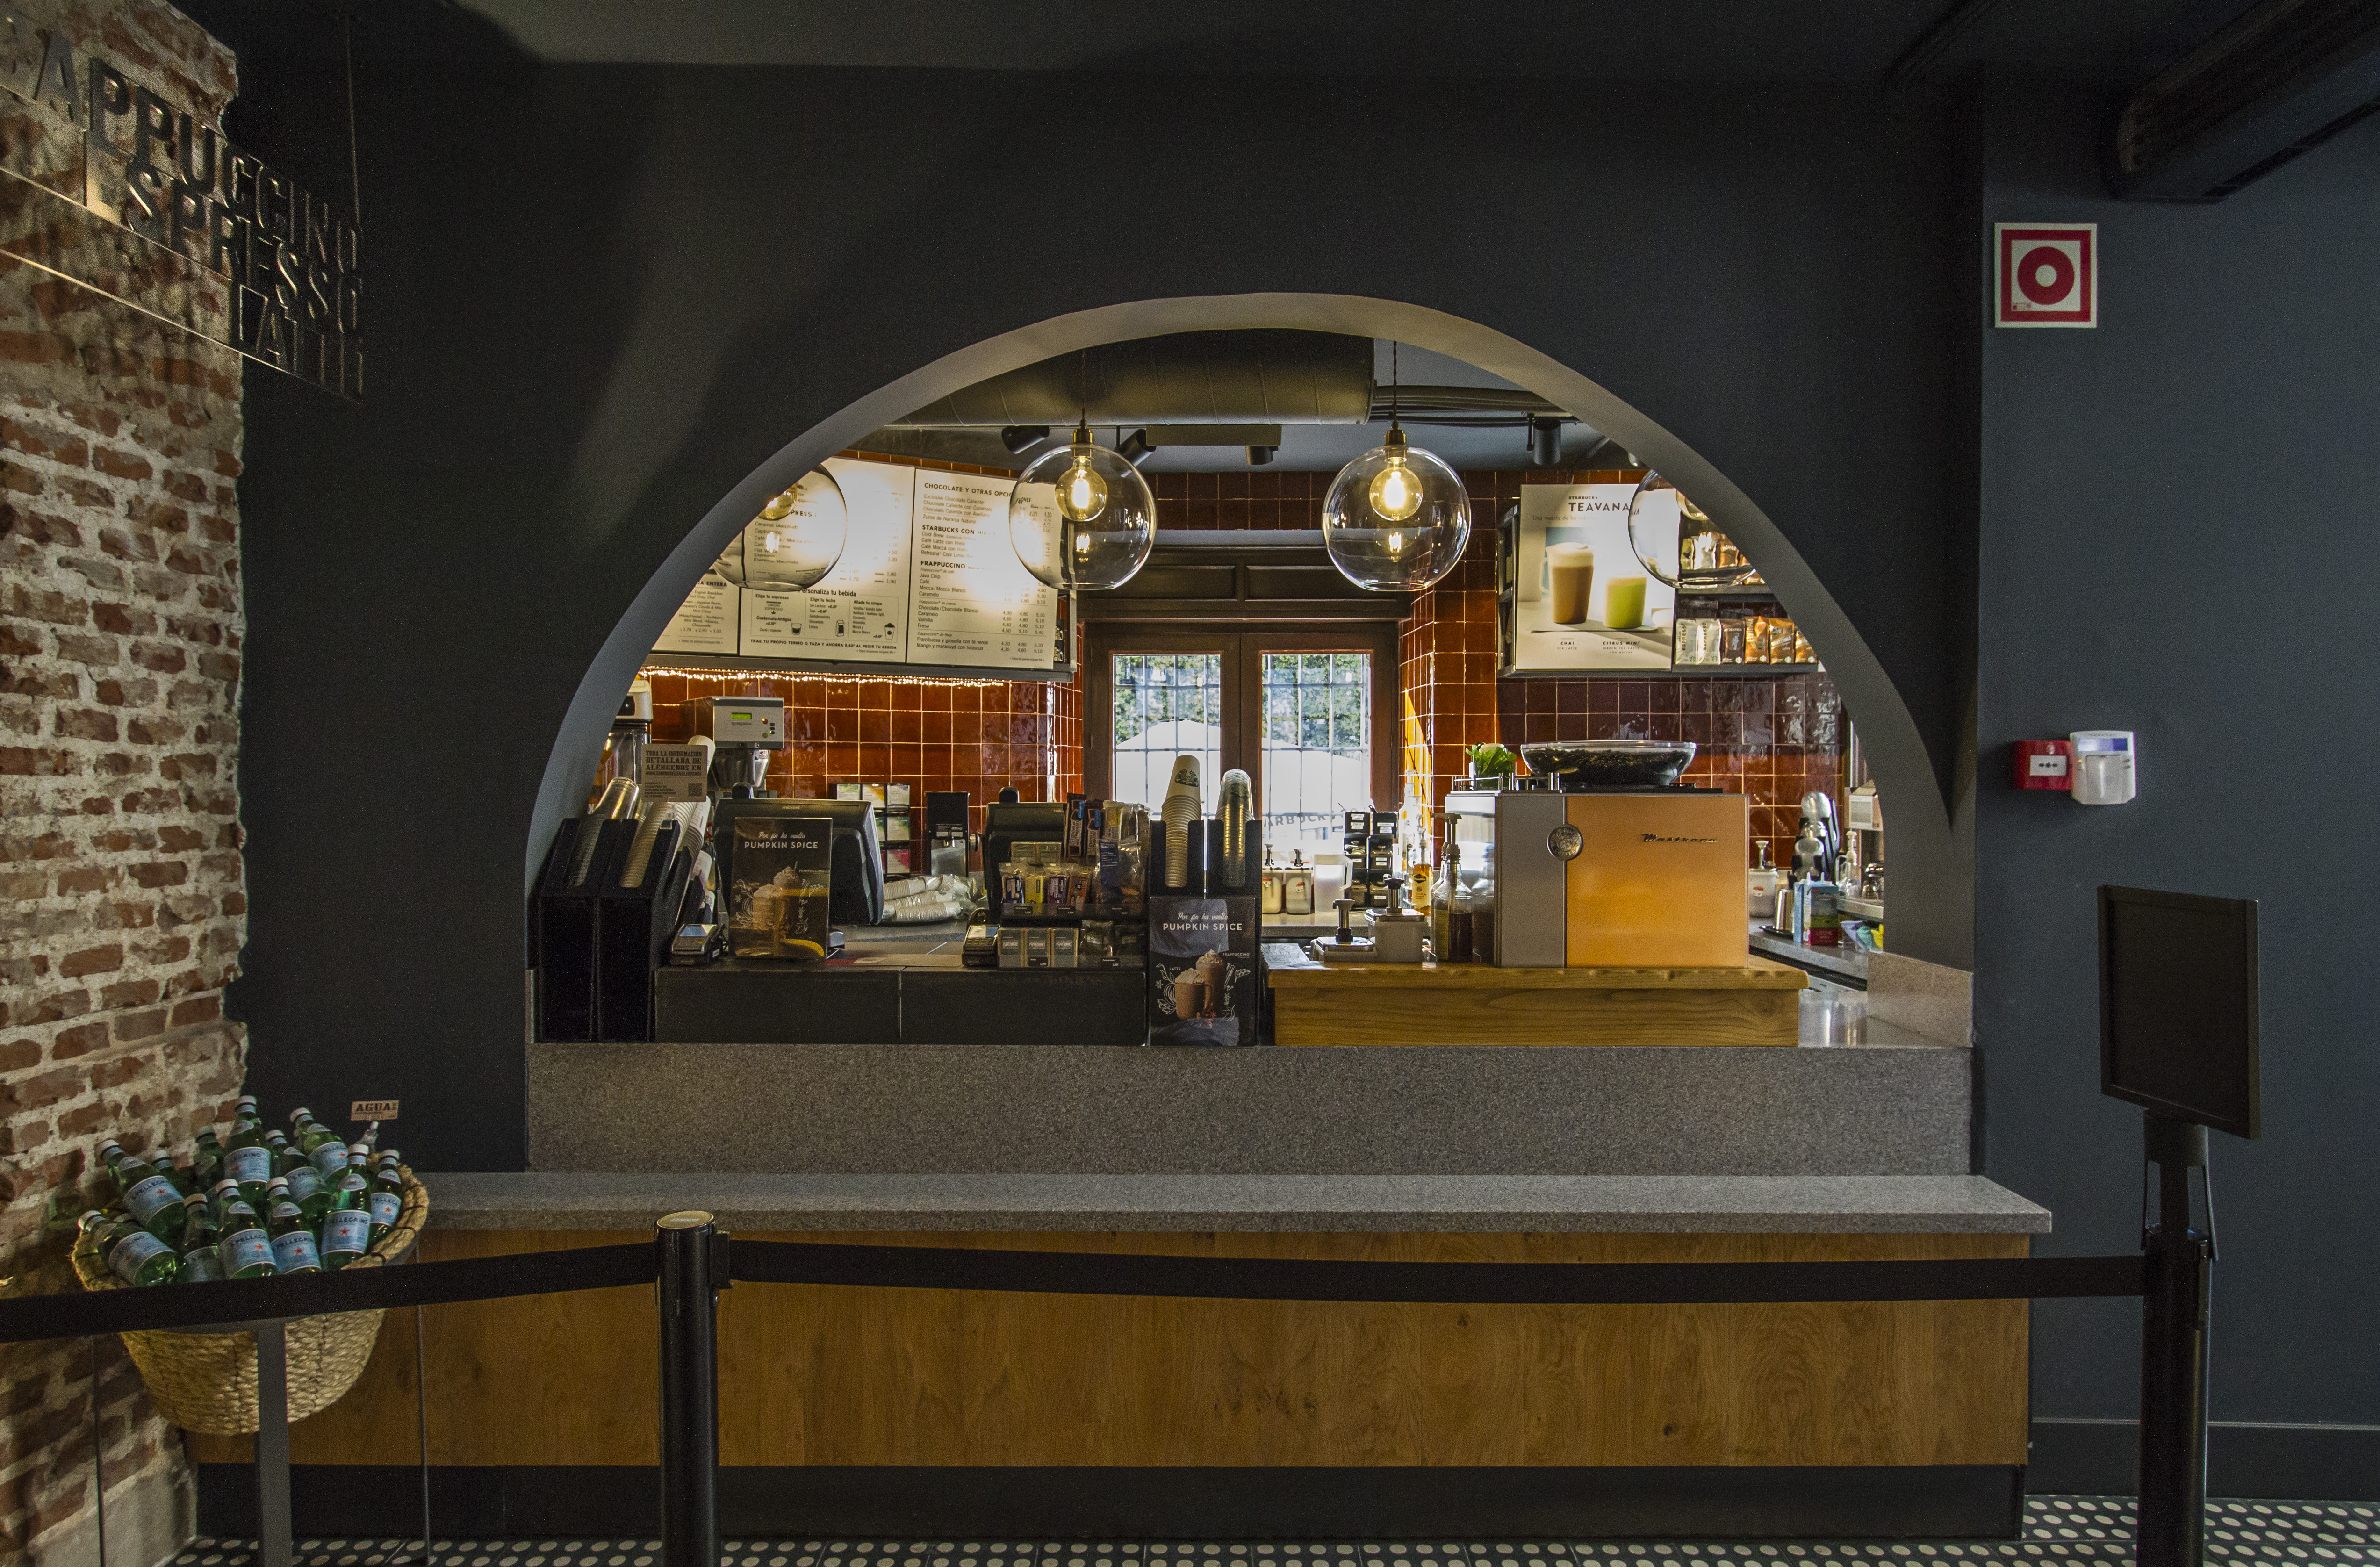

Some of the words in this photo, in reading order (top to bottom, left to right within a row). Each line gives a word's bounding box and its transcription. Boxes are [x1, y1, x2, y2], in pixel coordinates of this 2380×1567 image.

[924, 483, 963, 492] CHOCOLATE
[1568, 502, 1629, 512] TEAVANA
[922, 525, 958, 533] STARBUCKS
[921, 561, 965, 569] FRAPPUCCINO
[1189, 913, 1199, 922] fin
[356, 1102, 390, 1112] AGUA
